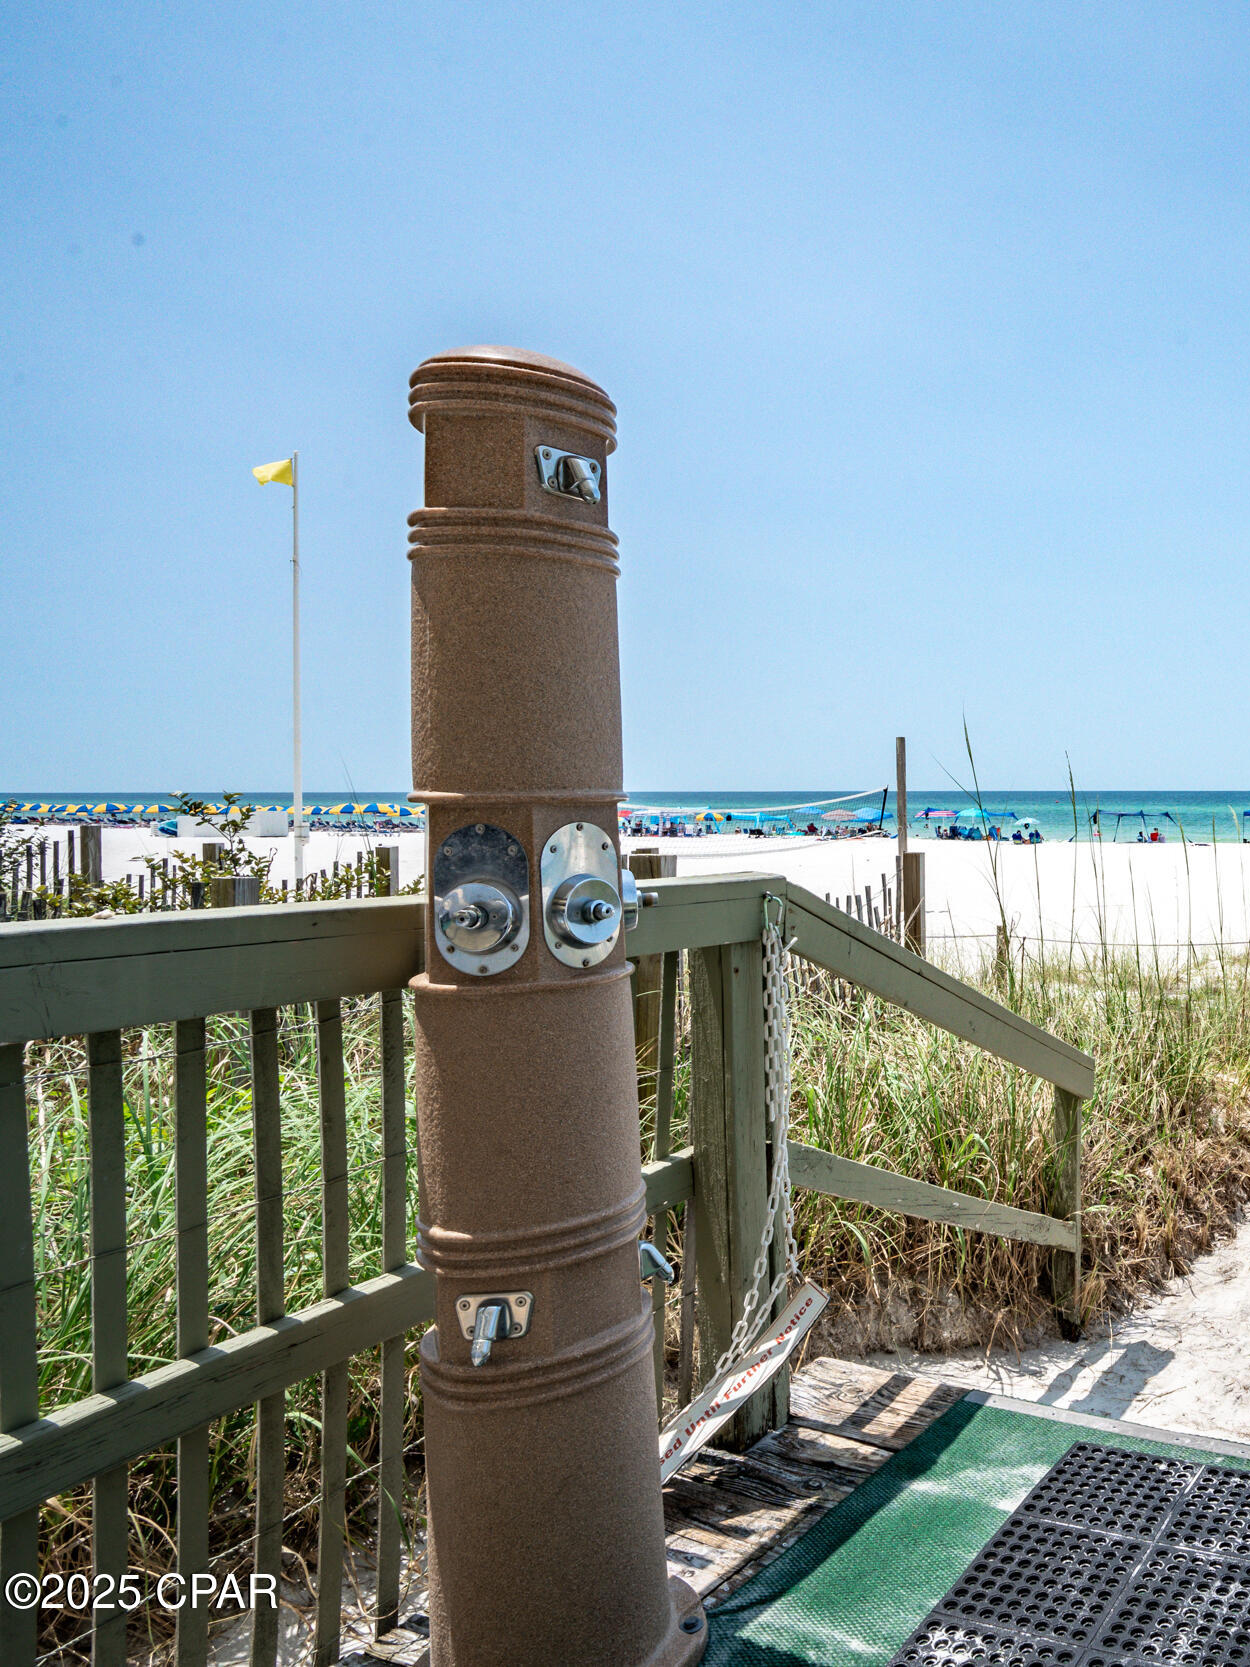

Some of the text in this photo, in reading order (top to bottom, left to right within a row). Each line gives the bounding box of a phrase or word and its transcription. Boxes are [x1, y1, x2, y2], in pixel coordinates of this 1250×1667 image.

[685, 1401, 721, 1437] Until
[723, 1347, 774, 1401] Further
[775, 1297, 814, 1346] Notice
